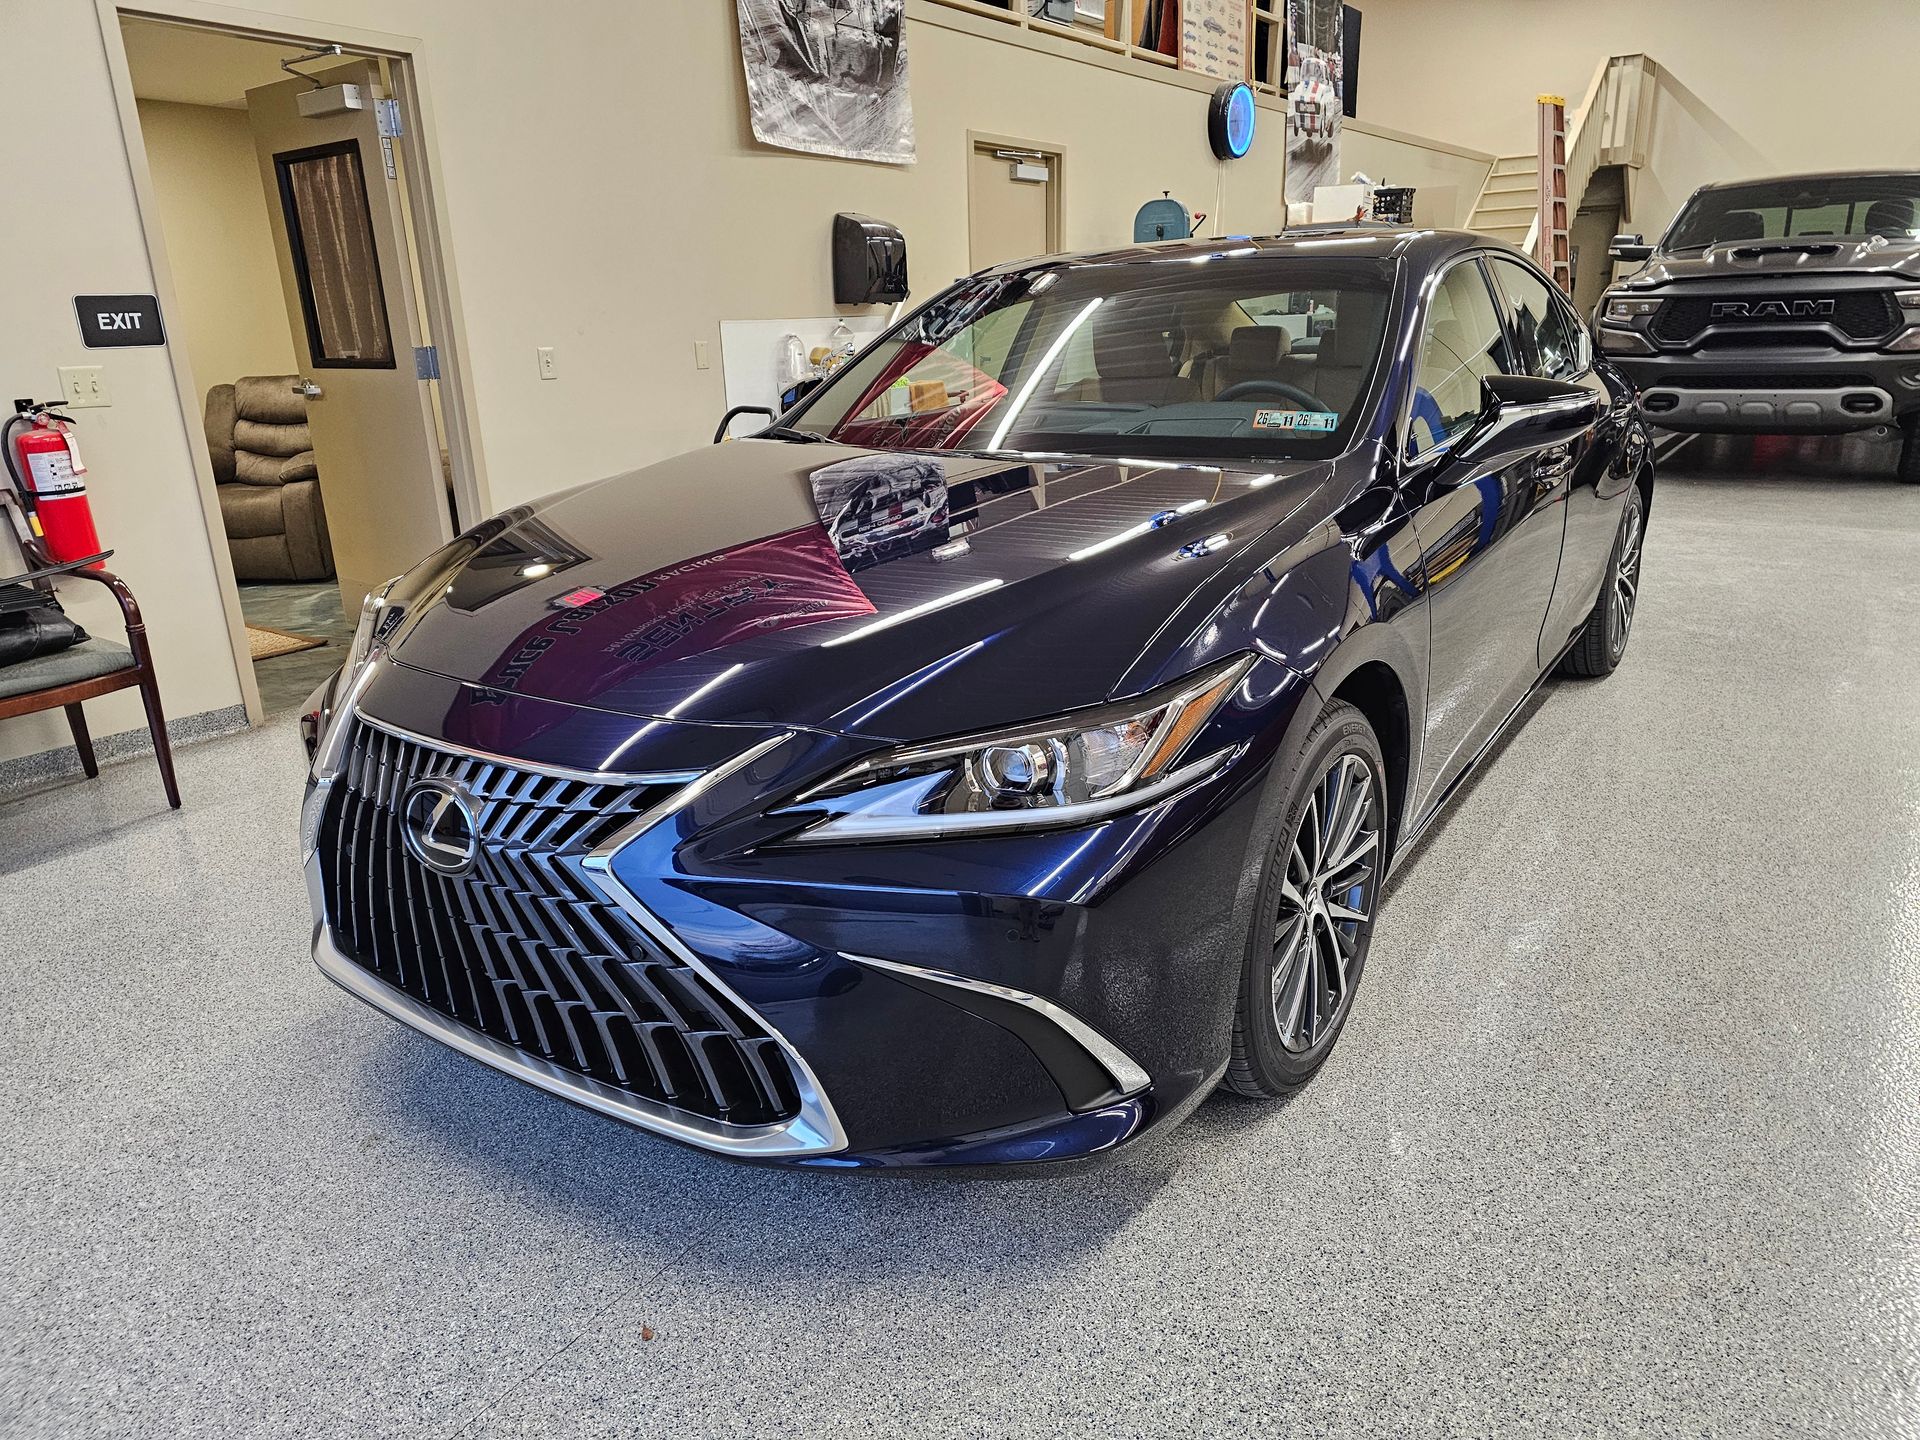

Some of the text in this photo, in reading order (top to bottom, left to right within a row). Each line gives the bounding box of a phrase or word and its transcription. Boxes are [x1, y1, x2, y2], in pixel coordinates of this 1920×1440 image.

[1711, 299, 1835, 317] RAM
[97, 312, 142, 330] EXIT
[1257, 412, 1269, 424] 26
[1283, 416, 1294, 426] 11
[1297, 414, 1335, 428] 26 11
